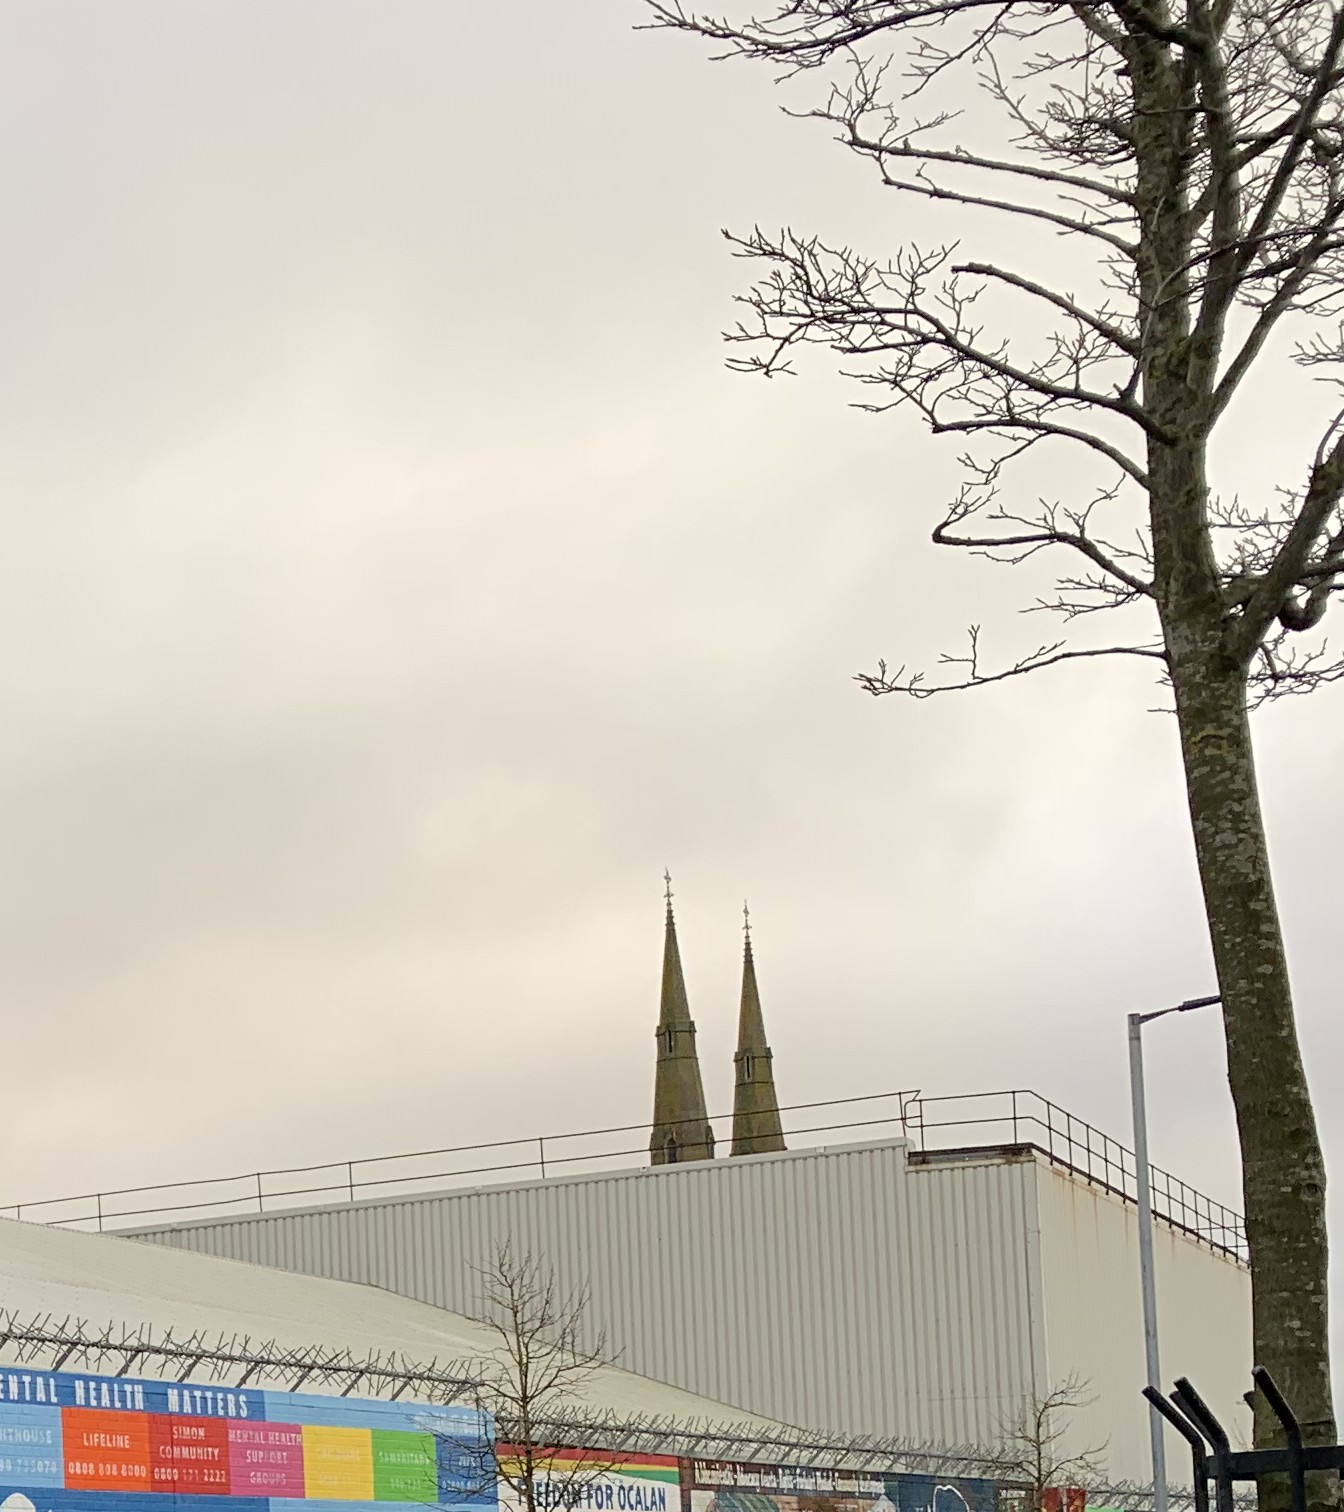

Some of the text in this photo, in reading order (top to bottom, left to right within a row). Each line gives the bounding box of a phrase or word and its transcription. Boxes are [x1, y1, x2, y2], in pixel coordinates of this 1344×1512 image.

[75, 1380, 144, 1410] HEALTH
[167, 1388, 248, 1418] MATTERS
[82, 1431, 130, 1449] LIFELINE
[172, 1426, 206, 1440] SIMON
[229, 1430, 302, 1446] MENTAL HEALTH
[159, 1444, 220, 1461] COMMUNITY
[68, 1461, 147, 1478] 0808 808 8000
[203, 1469, 227, 1483] 2222
[249, 1471, 287, 1485] GROUPS
[517, 1480, 582, 1510] FEEDOM
[587, 1483, 614, 1510] FOR
